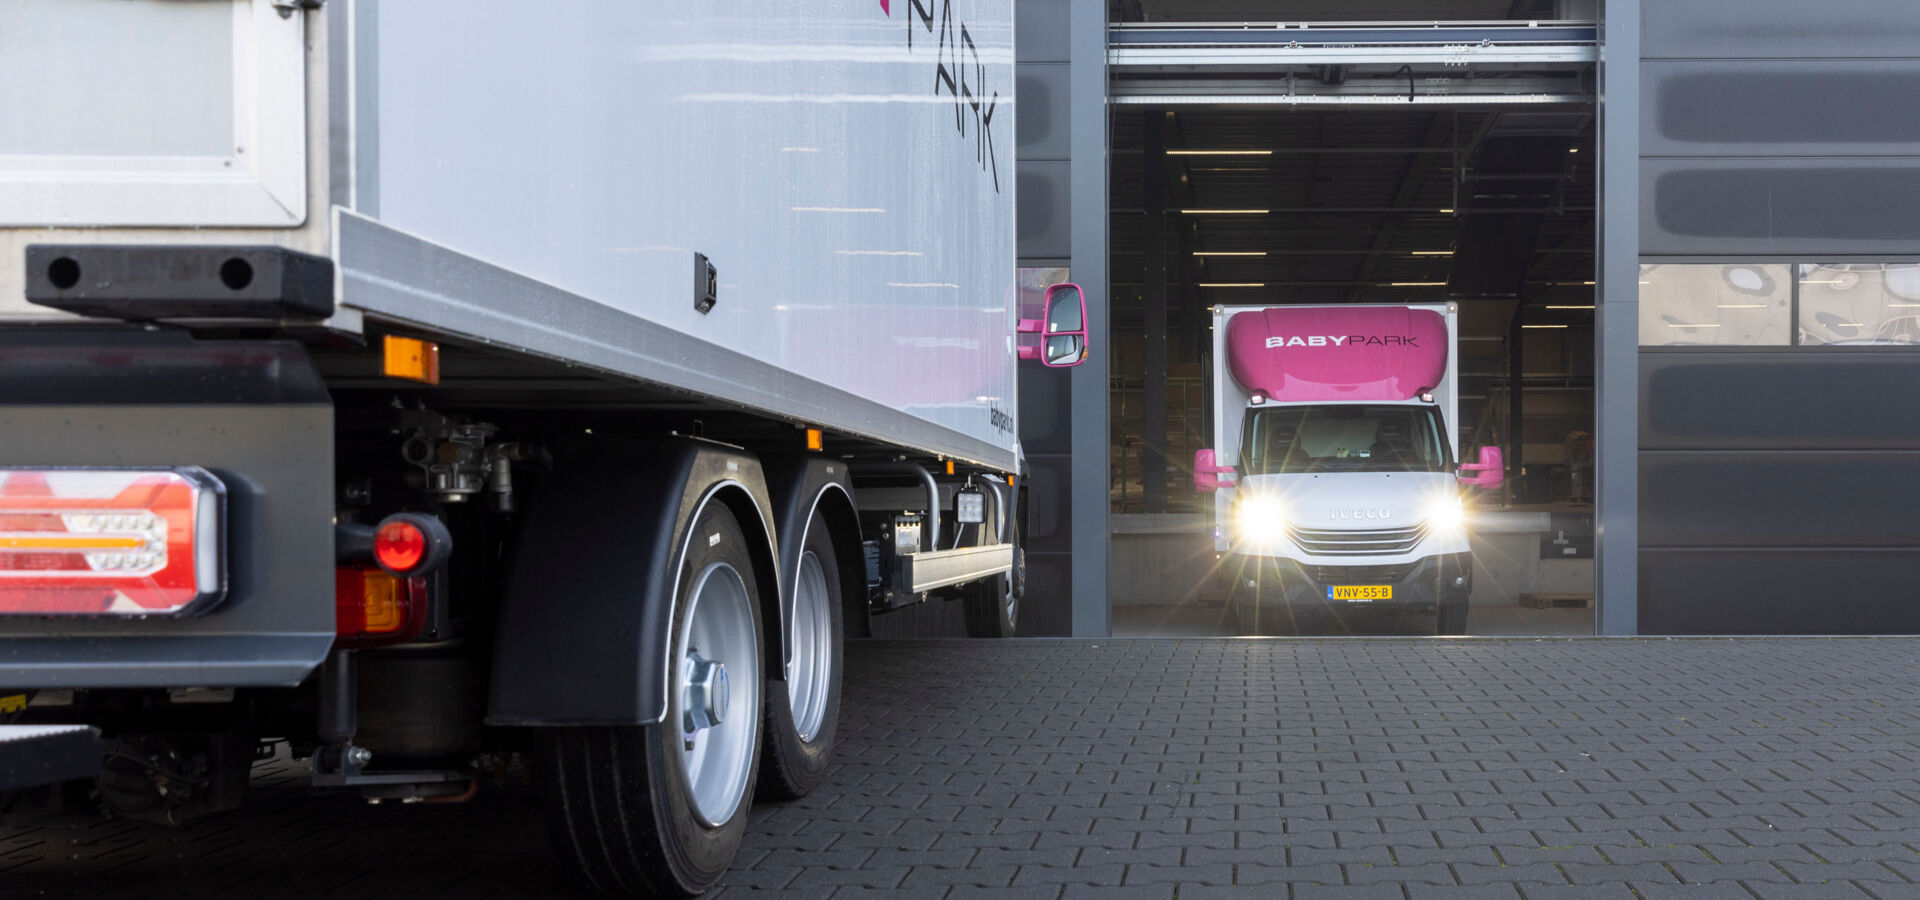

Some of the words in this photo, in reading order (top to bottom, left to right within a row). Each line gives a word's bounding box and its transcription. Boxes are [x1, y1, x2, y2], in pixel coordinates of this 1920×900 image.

[1265, 335, 1419, 348] BABYPARK
[1329, 508, 1391, 520] IVECO
[1336, 587, 1389, 598] VNV-55-B
